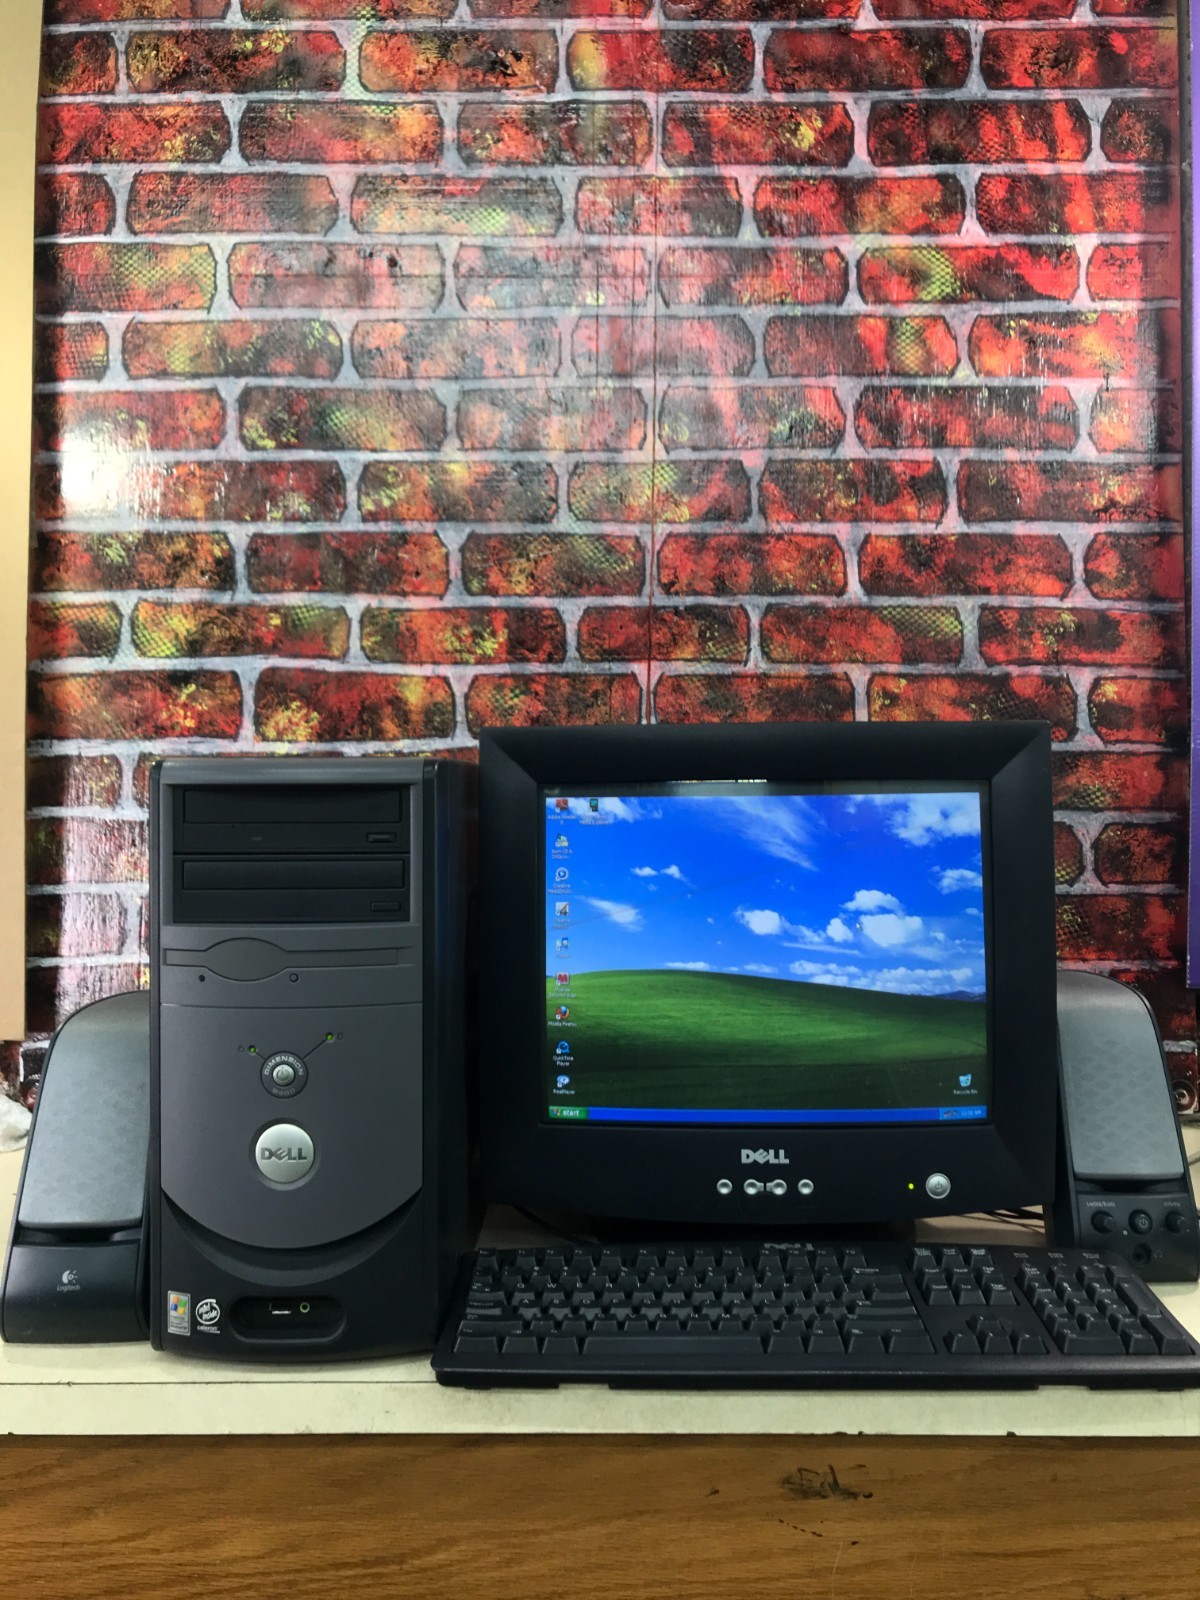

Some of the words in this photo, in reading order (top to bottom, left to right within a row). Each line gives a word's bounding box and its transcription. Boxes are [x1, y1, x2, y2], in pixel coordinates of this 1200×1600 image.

[264, 1055, 305, 1076] DIMENSION
[562, 1109, 579, 1117] start
[260, 1147, 308, 1162] DELL
[741, 1149, 790, 1164] DELL
[57, 1284, 81, 1293] Logitech
